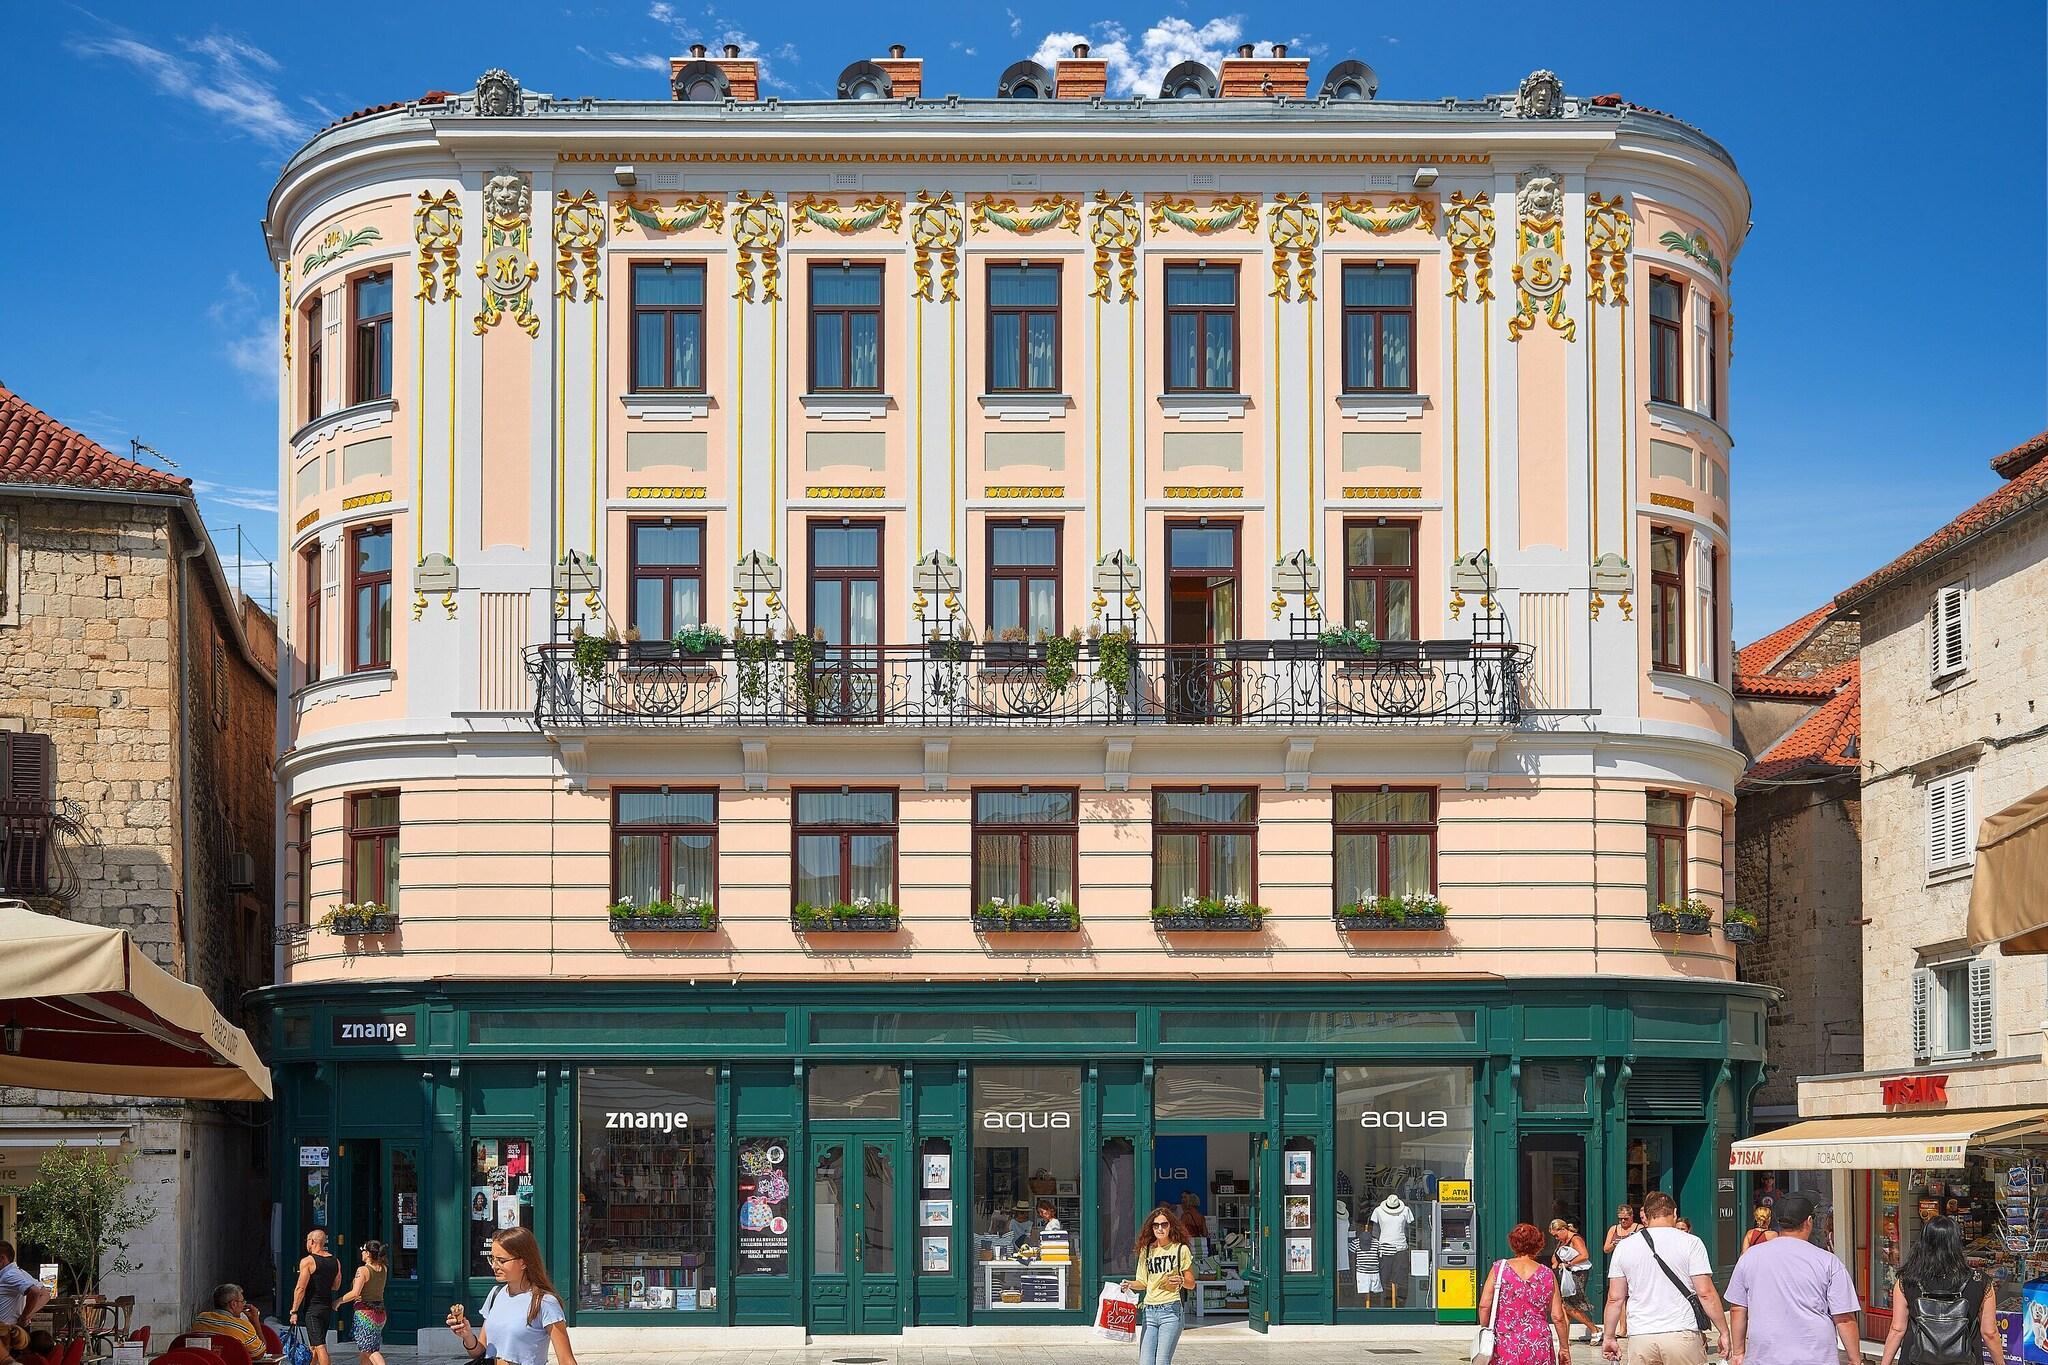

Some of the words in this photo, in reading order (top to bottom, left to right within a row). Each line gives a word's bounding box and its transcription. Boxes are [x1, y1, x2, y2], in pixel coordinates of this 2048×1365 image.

[341, 1022, 407, 1042] znanje
[1880, 1076, 1949, 1106] TISAK
[605, 1111, 689, 1134] znanje
[983, 1111, 1071, 1133] aqua
[1360, 1110, 1448, 1133] aqua
[1737, 1150, 1764, 1165] TISAK
[1817, 1152, 1854, 1164] TOBACCO
